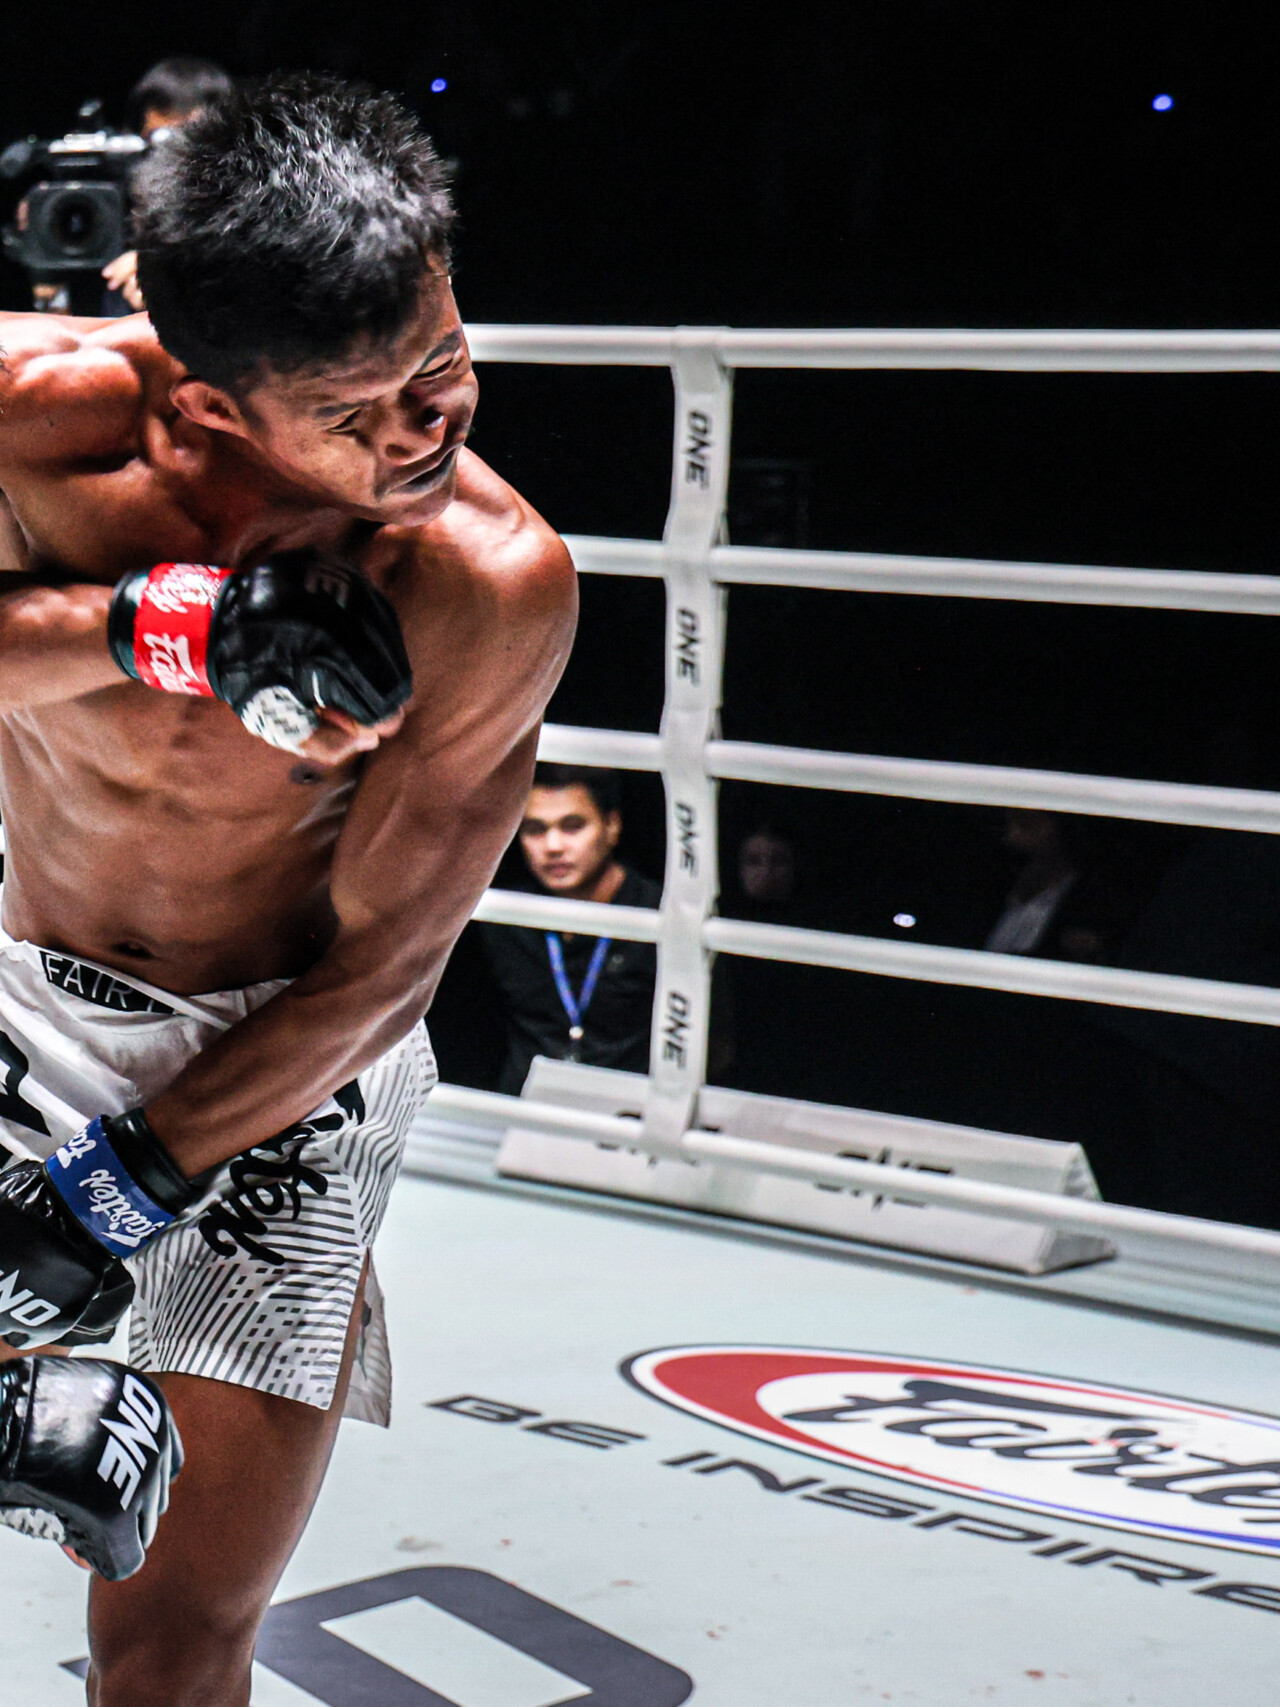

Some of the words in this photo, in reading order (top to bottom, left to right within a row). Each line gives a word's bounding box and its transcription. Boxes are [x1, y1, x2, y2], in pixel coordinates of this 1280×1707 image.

[686, 409, 713, 489] ONE
[676, 607, 700, 687] ONE
[676, 802, 699, 878] ONE
[662, 990, 690, 1070] ONE
[79, 1169, 166, 1248] Fairtex
[97, 1374, 161, 1511] ONE
[424, 1393, 649, 1451] BE
[659, 1450, 1280, 1615] INSPIRE
